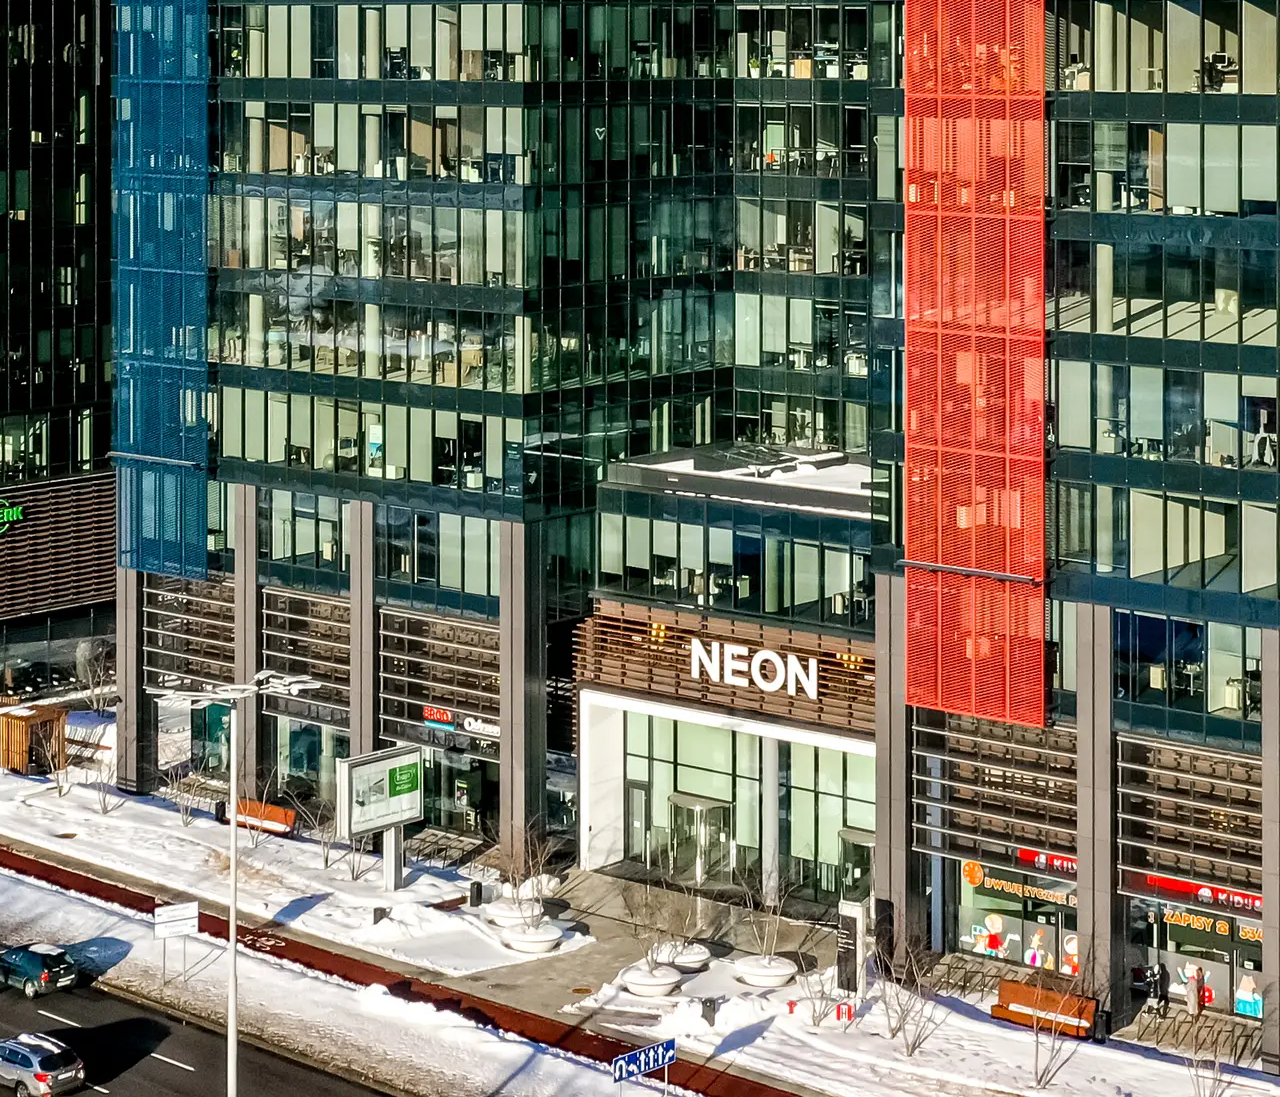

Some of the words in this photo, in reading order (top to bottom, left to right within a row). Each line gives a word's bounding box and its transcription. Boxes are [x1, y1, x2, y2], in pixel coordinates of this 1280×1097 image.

[691, 637, 818, 700] NEON
[423, 705, 453, 723] ERGO
[1163, 908, 1214, 932] ZAPISY
